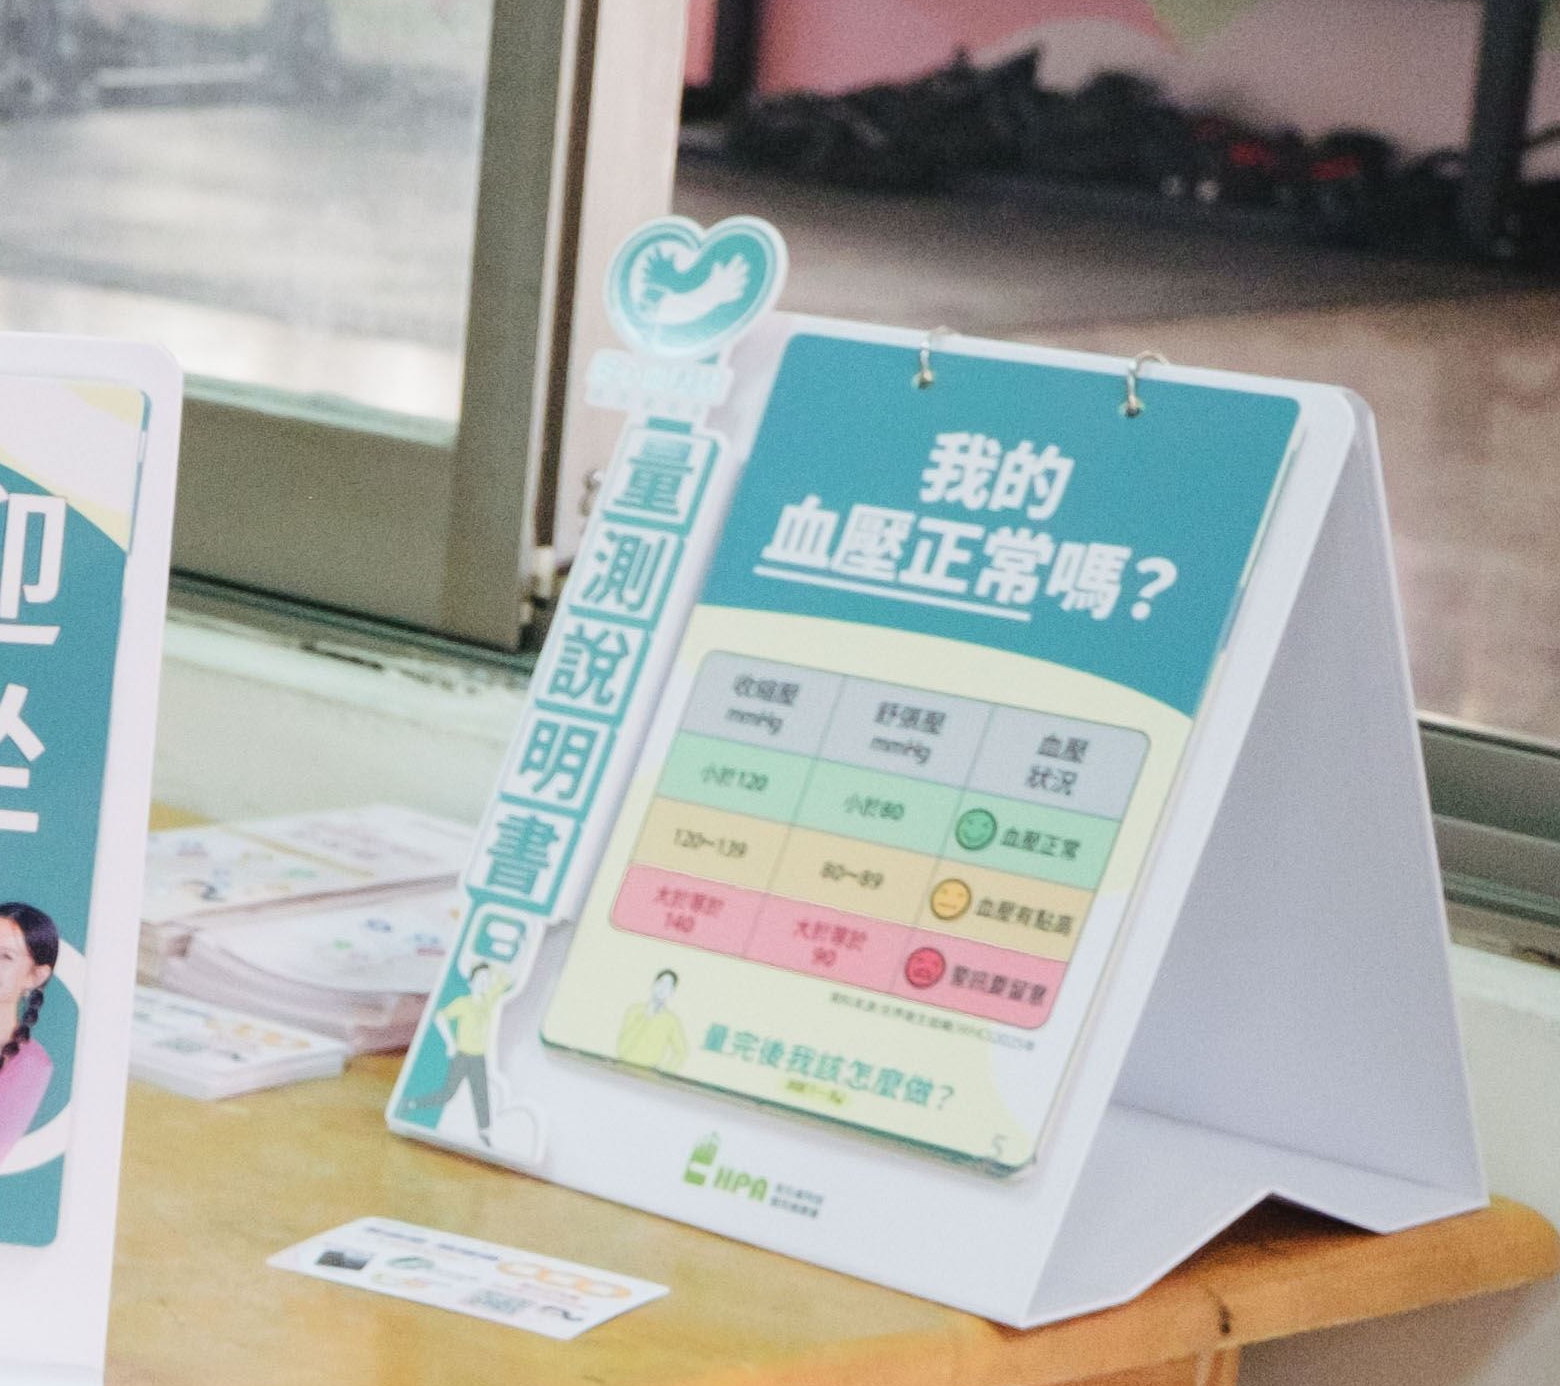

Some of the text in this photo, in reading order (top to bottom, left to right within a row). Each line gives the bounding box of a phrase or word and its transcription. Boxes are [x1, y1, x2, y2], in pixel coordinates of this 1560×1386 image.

[920, 431, 1074, 517] 我的
[483, 431, 699, 898] 量測說明書
[733, 674, 800, 706] 收縮壓
[725, 706, 783, 735] mmHg
[873, 702, 947, 735] 舒張壓
[869, 735, 930, 765] mmHg
[1037, 732, 1089, 764] 血壓
[1025, 766, 1078, 797] 狀況
[1000, 826, 1081, 861] 血壓正常
[663, 913, 695, 935] 140
[812, 948, 837, 968] 90
